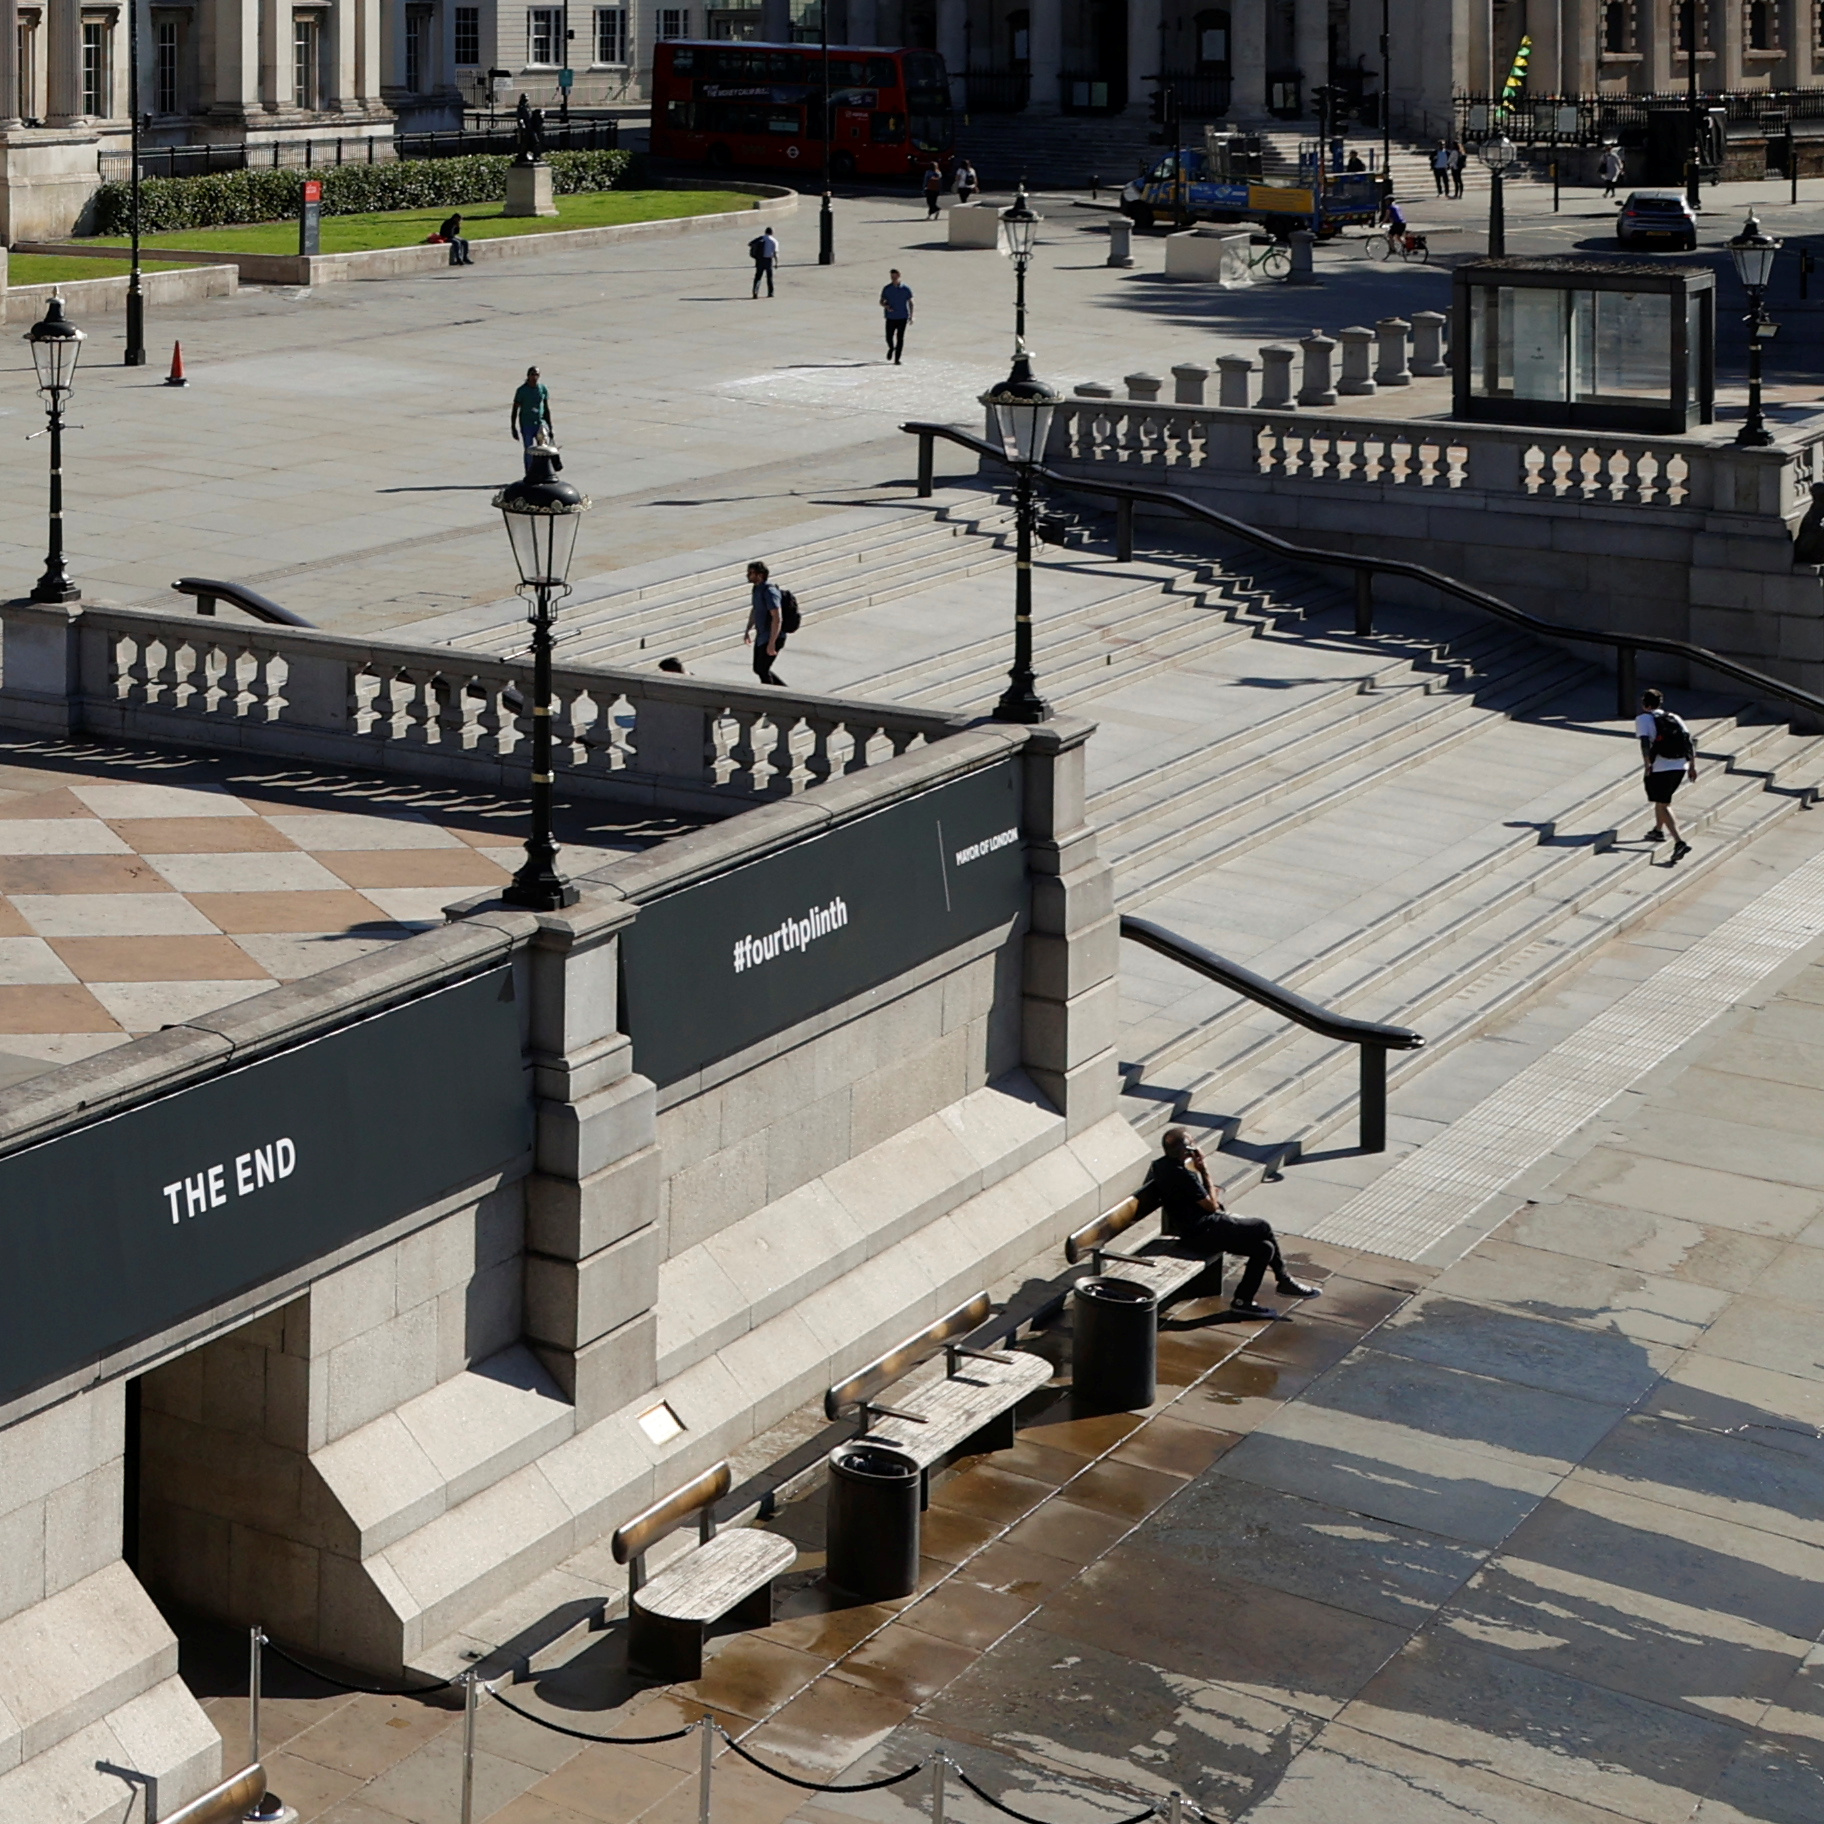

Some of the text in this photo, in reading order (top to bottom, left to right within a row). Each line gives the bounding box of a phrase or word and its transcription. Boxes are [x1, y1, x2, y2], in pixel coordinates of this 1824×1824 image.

[955, 826, 1019, 866] MAYOR OF LONDON
[733, 896, 849, 974] #fourthplinth
[163, 1137, 297, 1225] THE END
